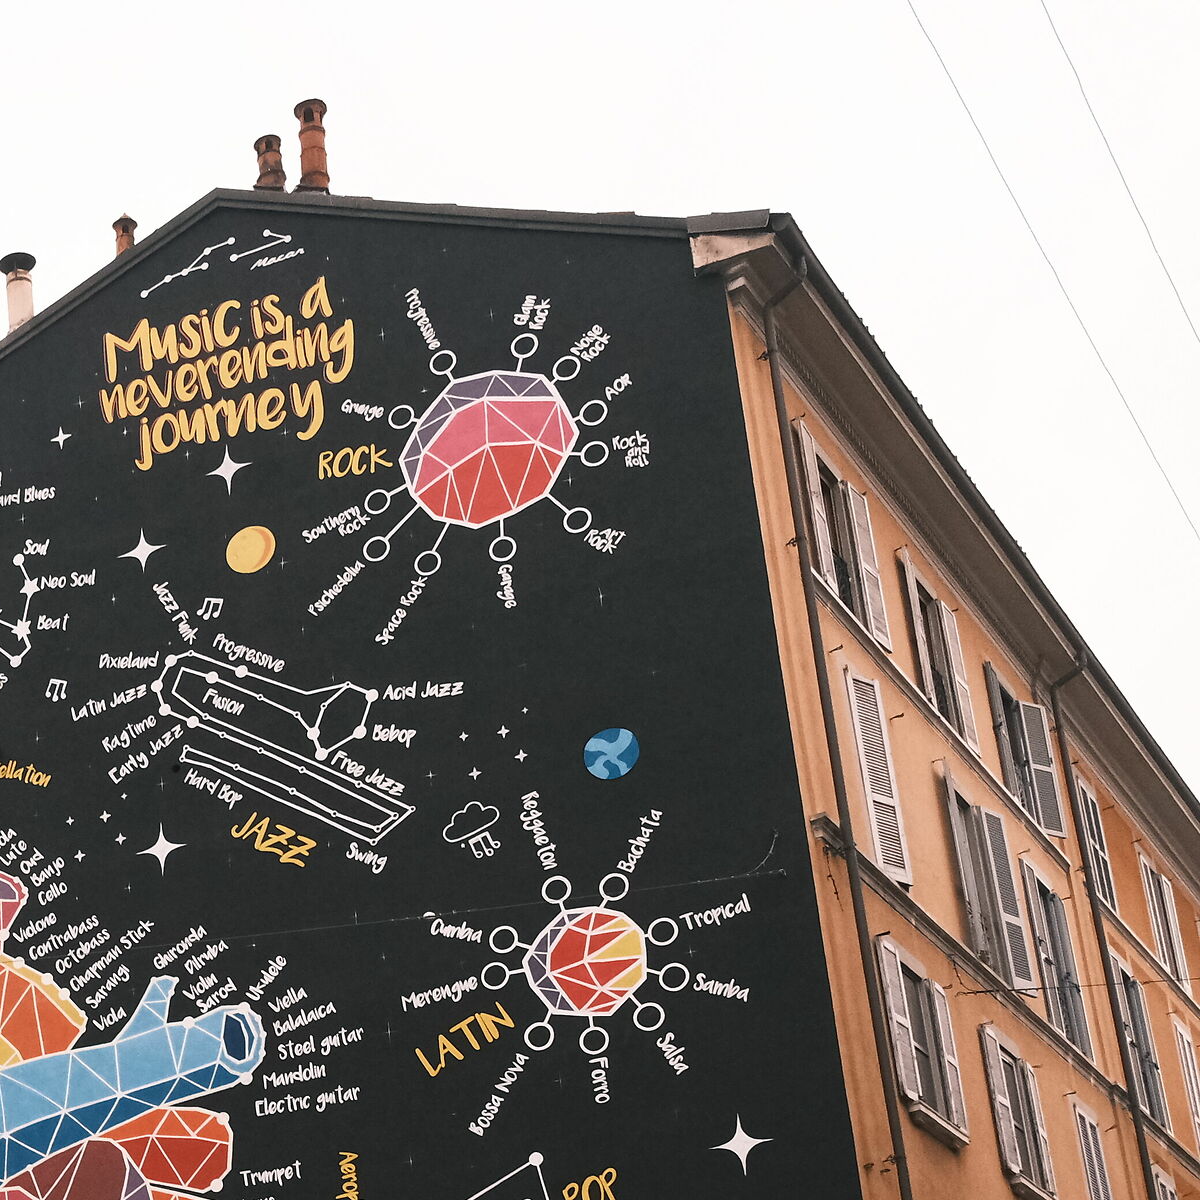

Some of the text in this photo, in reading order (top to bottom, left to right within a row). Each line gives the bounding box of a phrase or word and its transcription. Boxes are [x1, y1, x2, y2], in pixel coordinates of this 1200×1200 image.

[251, 248, 304, 269] Macan
[104, 276, 333, 383] Music is a
[405, 288, 441, 350] Progressive
[529, 298, 551, 330] Rock
[100, 318, 354, 423] neverending
[135, 379, 325, 470] journey
[341, 399, 384, 420] Grunge
[612, 431, 648, 451] Rock
[319, 444, 393, 480] ROCK
[24, 486, 56, 503] Blues
[302, 506, 361, 543] Southern
[23, 539, 50, 556] Soul
[37, 613, 70, 630] Beat
[375, 576, 428, 645] Space Rock
[213, 633, 285, 673] Progressive
[71, 684, 147, 722] Latin Jazz
[202, 688, 245, 716] Fusion
[383, 682, 464, 701] Acid Jazz
[102, 715, 157, 753] Ragtime
[108, 724, 185, 785] Early Jazz
[331, 751, 406, 797] Free Jazz
[231, 812, 317, 867] JAZZ
[519, 790, 558, 871] Reggaeton
[616, 809, 664, 873] Bachata
[0, 840, 27, 867] Lute
[346, 841, 388, 874] Swing
[38, 882, 68, 906] Cello
[679, 893, 751, 931] Tropical
[28, 914, 100, 962] Contrabass
[55, 928, 111, 975] Octobass
[69, 919, 155, 993] Chapman Stick
[195, 976, 238, 1014] Sarod
[245, 955, 287, 1002] Ukulele
[401, 975, 478, 1012] Merengue
[693, 973, 750, 1002] Samba
[92, 1005, 128, 1032] Viola
[277, 1026, 364, 1061] Steel guitar
[415, 1001, 515, 1078] LATIN
[656, 1032, 689, 1076] Salsa
[262, 1062, 327, 1090] Mandolin
[468, 1052, 530, 1137] Bossa Nova
[254, 1084, 361, 1117] Electric guitar
[239, 1159, 302, 1188] Trumpet
